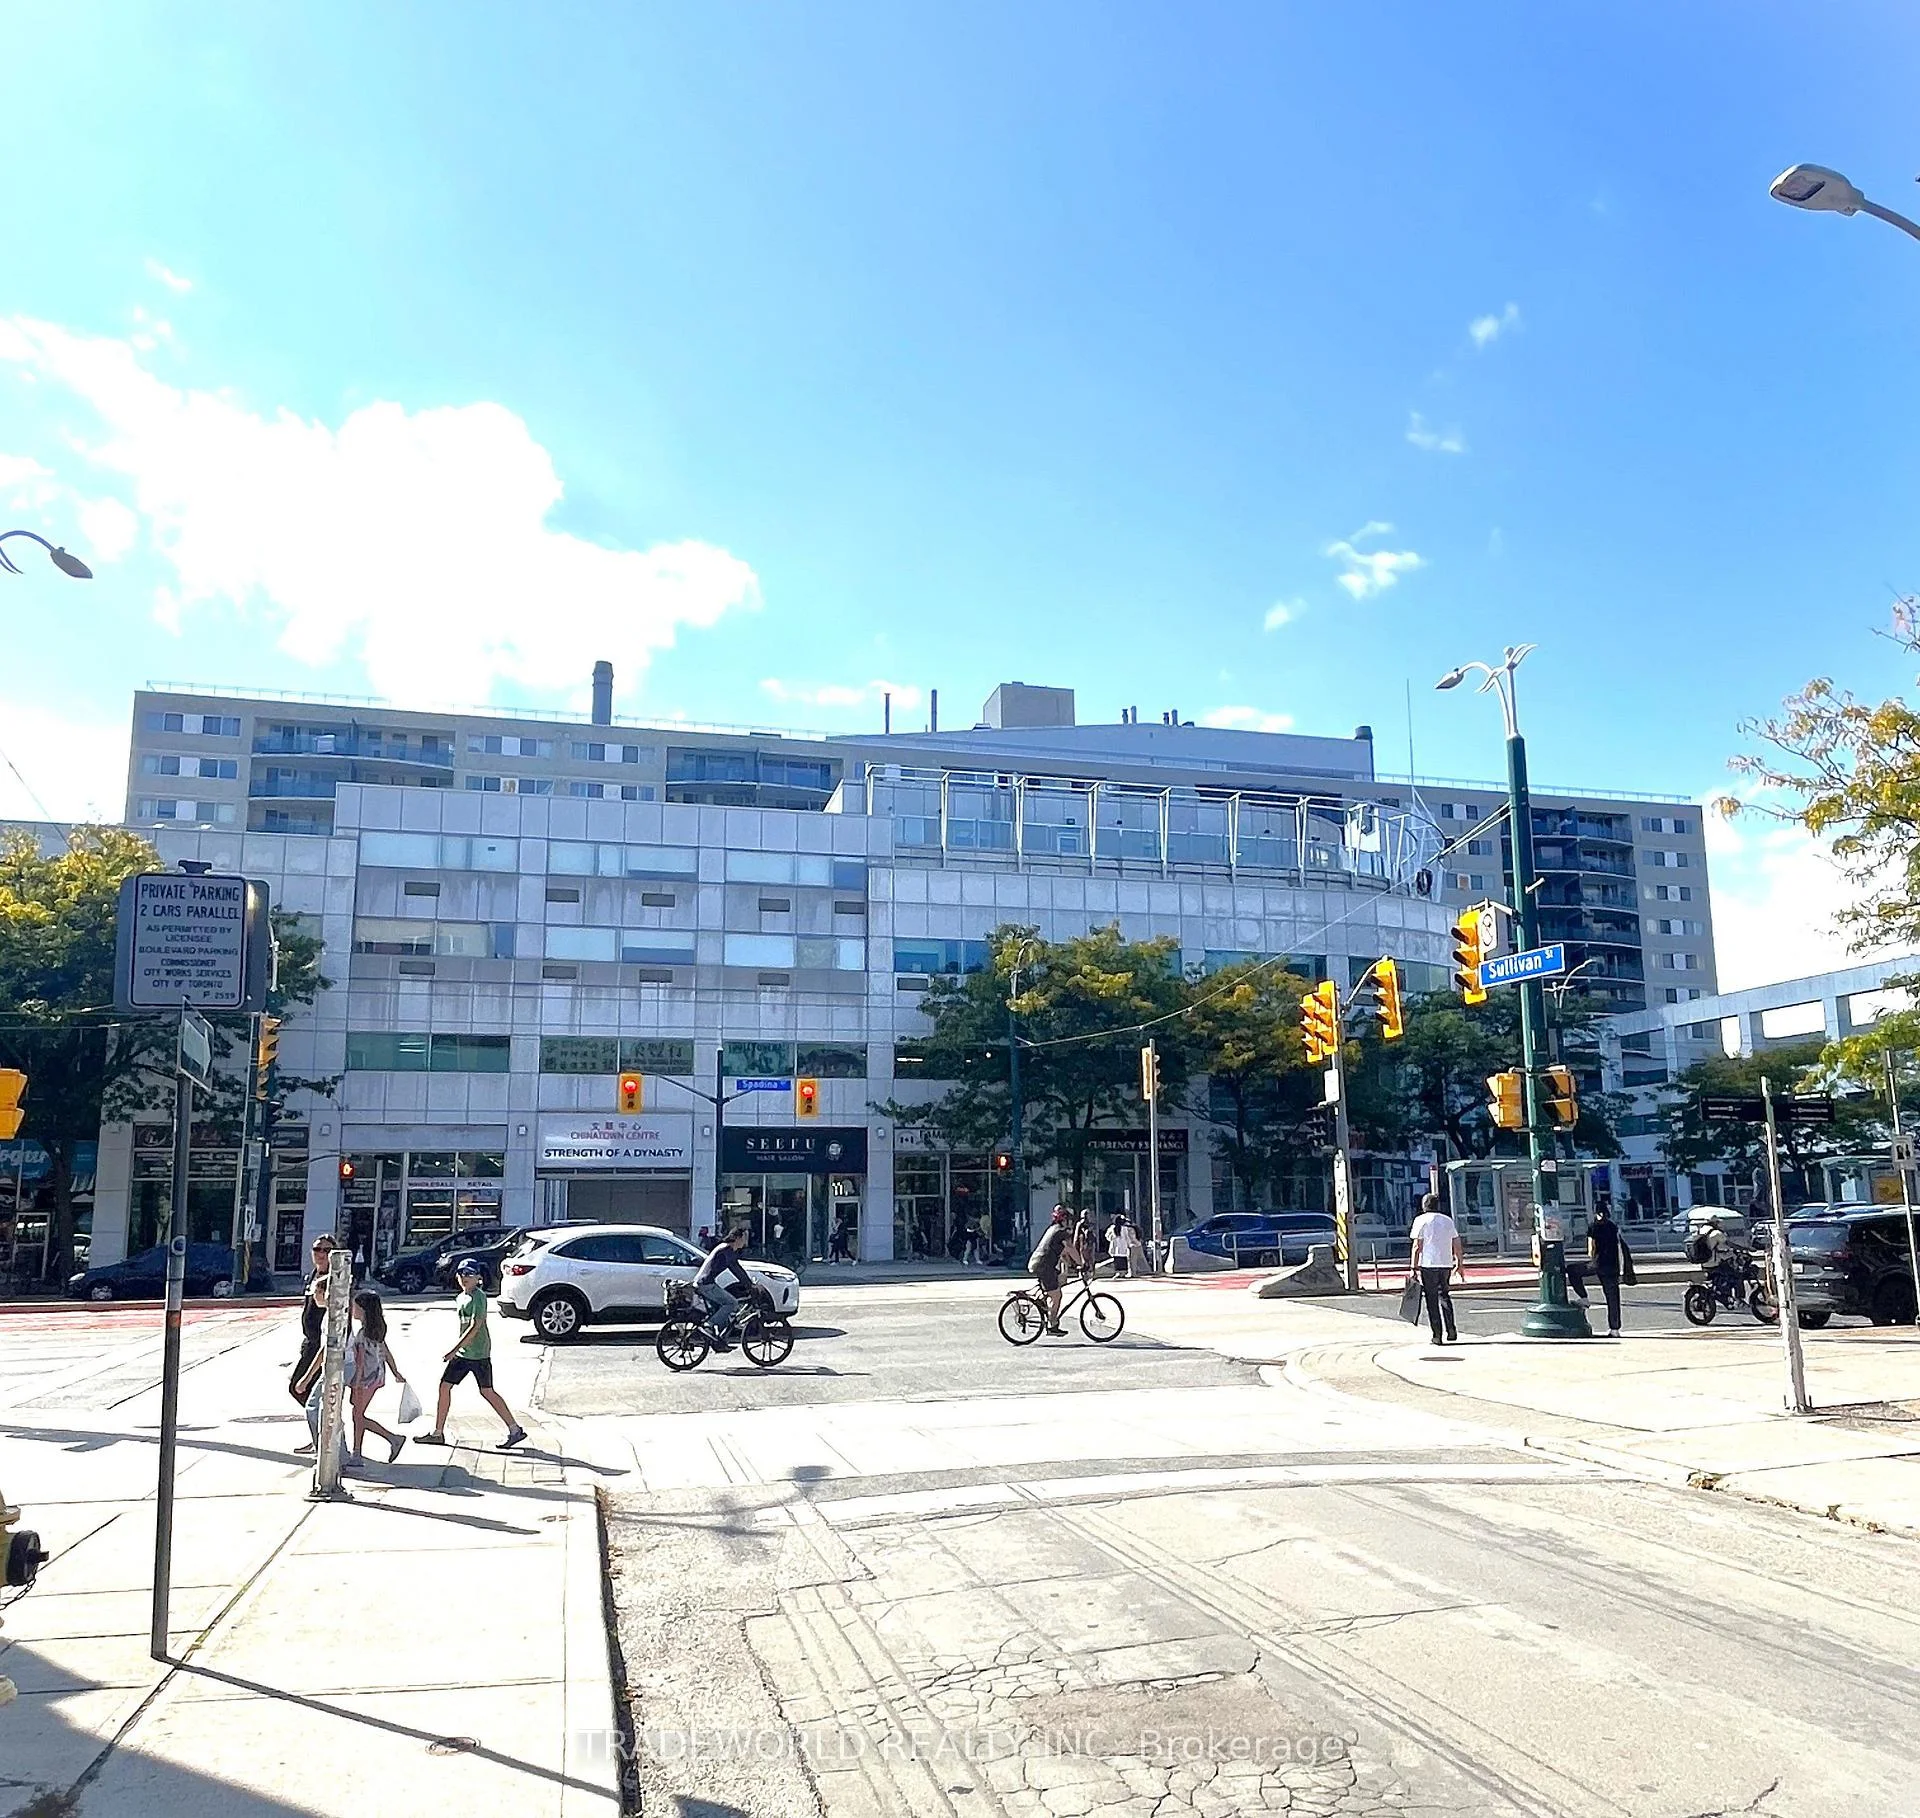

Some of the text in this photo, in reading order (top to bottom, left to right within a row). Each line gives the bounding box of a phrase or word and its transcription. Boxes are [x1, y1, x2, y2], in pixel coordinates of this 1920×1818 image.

[142, 884, 240, 901] PRIVATE PARKING
[140, 904, 240, 920] 2 CARS PARALLEL
[146, 924, 233, 934] AS PERMITTED BY
[165, 935, 212, 943] LICENSEE
[139, 946, 238, 956] BOULEVARD PARKING
[161, 959, 216, 967] COMMISSIONER
[1489, 949, 1554, 979] Sullivan St
[144, 969, 233, 978] CITY WORKS SERVICES
[152, 980, 223, 988] CITY OF TORONTO
[743, 1080, 782, 1090] Spadina
[571, 1131, 660, 1140] CHINATOWN CENTRE
[1088, 1141, 1135, 1150] CURRENCY
[544, 1148, 683, 1158] STRENGTH OF A DYNASTY
